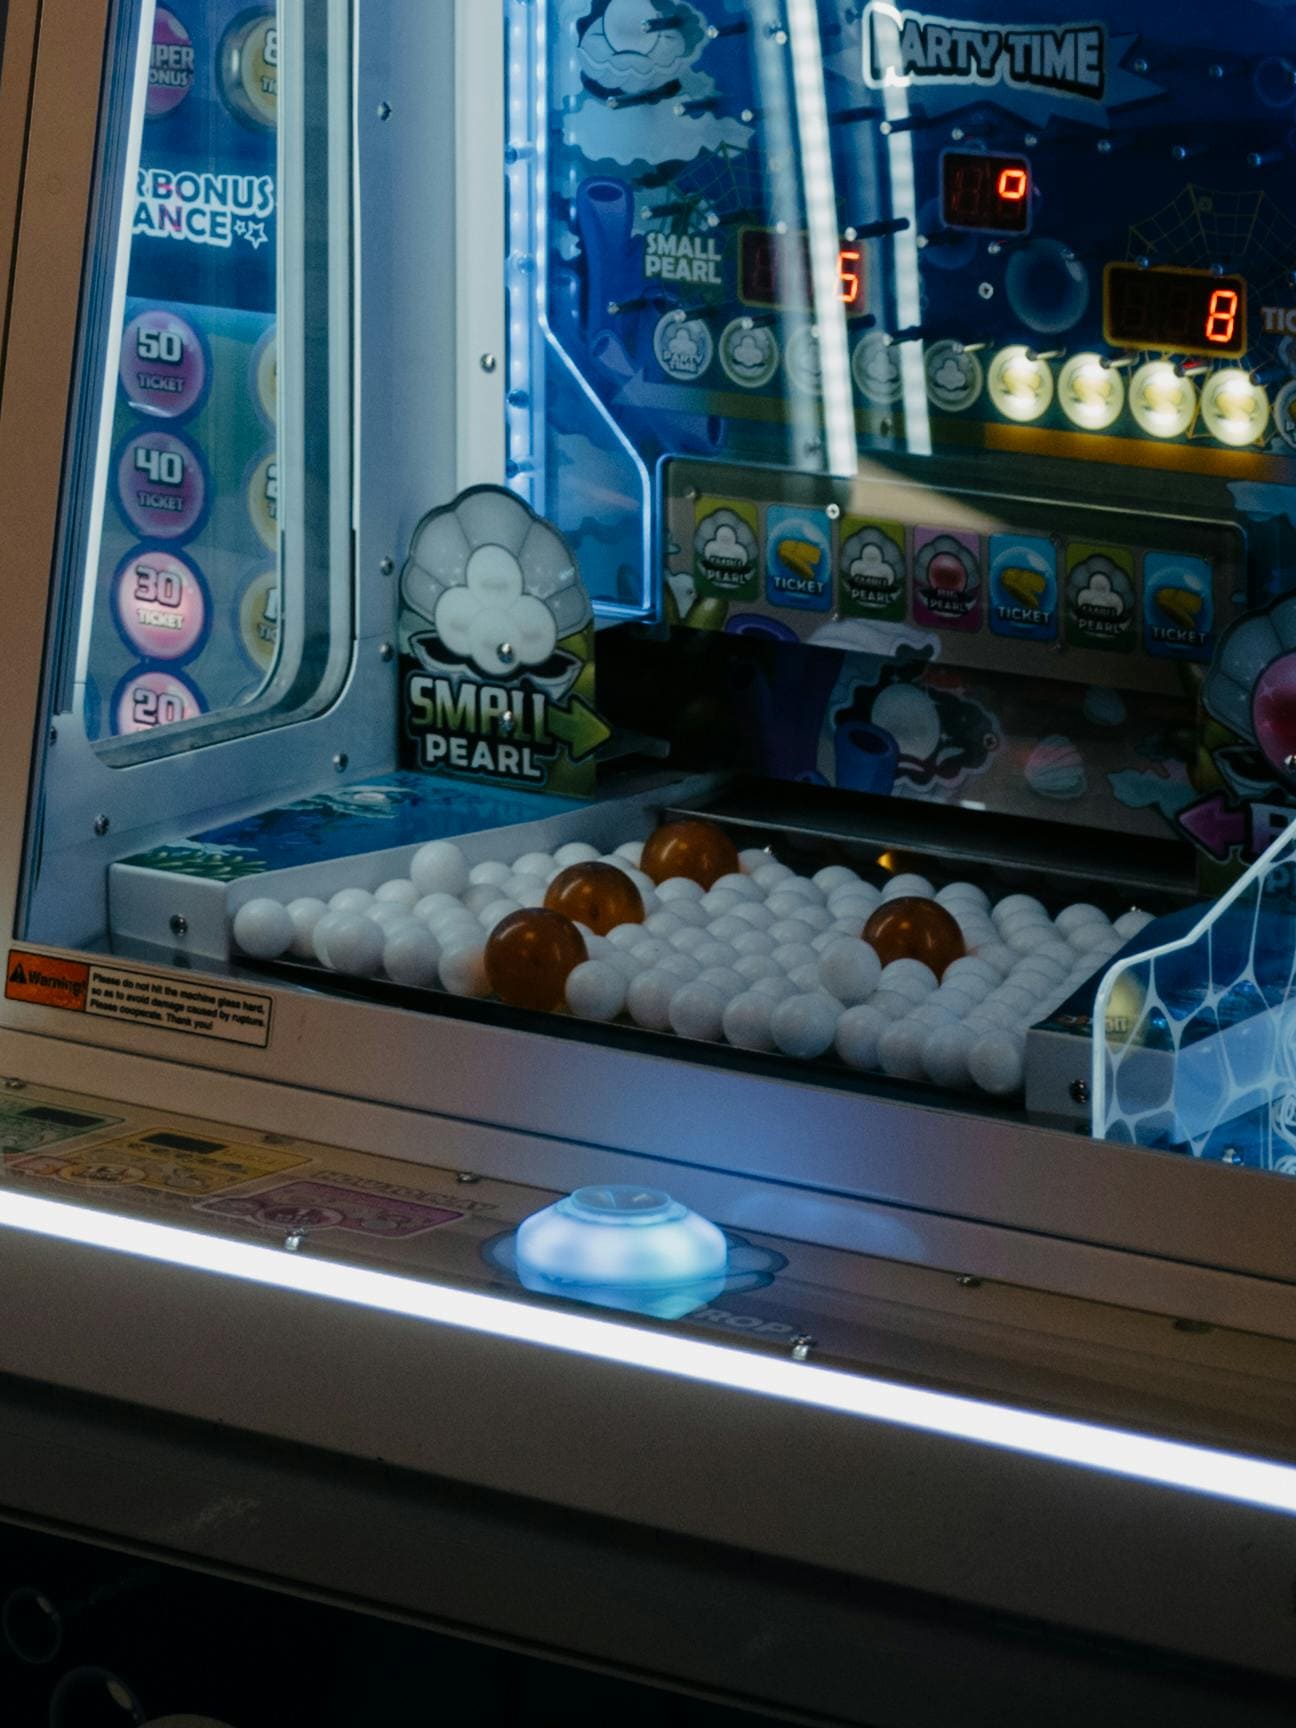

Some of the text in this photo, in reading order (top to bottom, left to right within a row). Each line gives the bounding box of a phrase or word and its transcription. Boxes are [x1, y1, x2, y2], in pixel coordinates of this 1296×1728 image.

[1006, 30, 1100, 88] TIME
[998, 170, 1028, 200] 0
[645, 232, 722, 262] SMALL
[645, 255, 722, 285] PEARL
[1205, 290, 1238, 344] 8
[136, 326, 184, 363] 50
[138, 373, 185, 394] TICKET
[135, 447, 185, 485] 40
[138, 490, 185, 512] TICKET
[135, 565, 184, 606] 30
[706, 566, 753, 584] PEARL
[773, 574, 825, 594] TICKET
[850, 586, 899, 604] PEARL
[926, 596, 970, 613] PEARL
[137, 604, 185, 630] TICKET
[997, 604, 1051, 625] TICKET
[1077, 616, 1132, 632] PEARL
[1151, 624, 1207, 645] TICKET
[132, 686, 185, 725] 20
[409, 676, 548, 745] SMALL
[424, 733, 542, 779] PEARL
[27, 970, 86, 996] Warning!
[92, 972, 121, 986] Please
[123, 978, 134, 988] do
[135, 980, 150, 992] not
[151, 983, 163, 995] hit
[164, 985, 178, 997] the
[179, 988, 215, 1006] machine
[218, 996, 241, 1010] glass
[90, 998, 118, 1013] Please
[166, 1013, 192, 1027] Thank
[91, 987, 102, 997] so
[104, 990, 114, 999] as
[116, 991, 124, 1001] to
[126, 992, 150, 1006] avoid
[151, 997, 185, 1013] damage
[187, 1003, 218, 1018] caused
[219, 1007, 231, 1021] by
